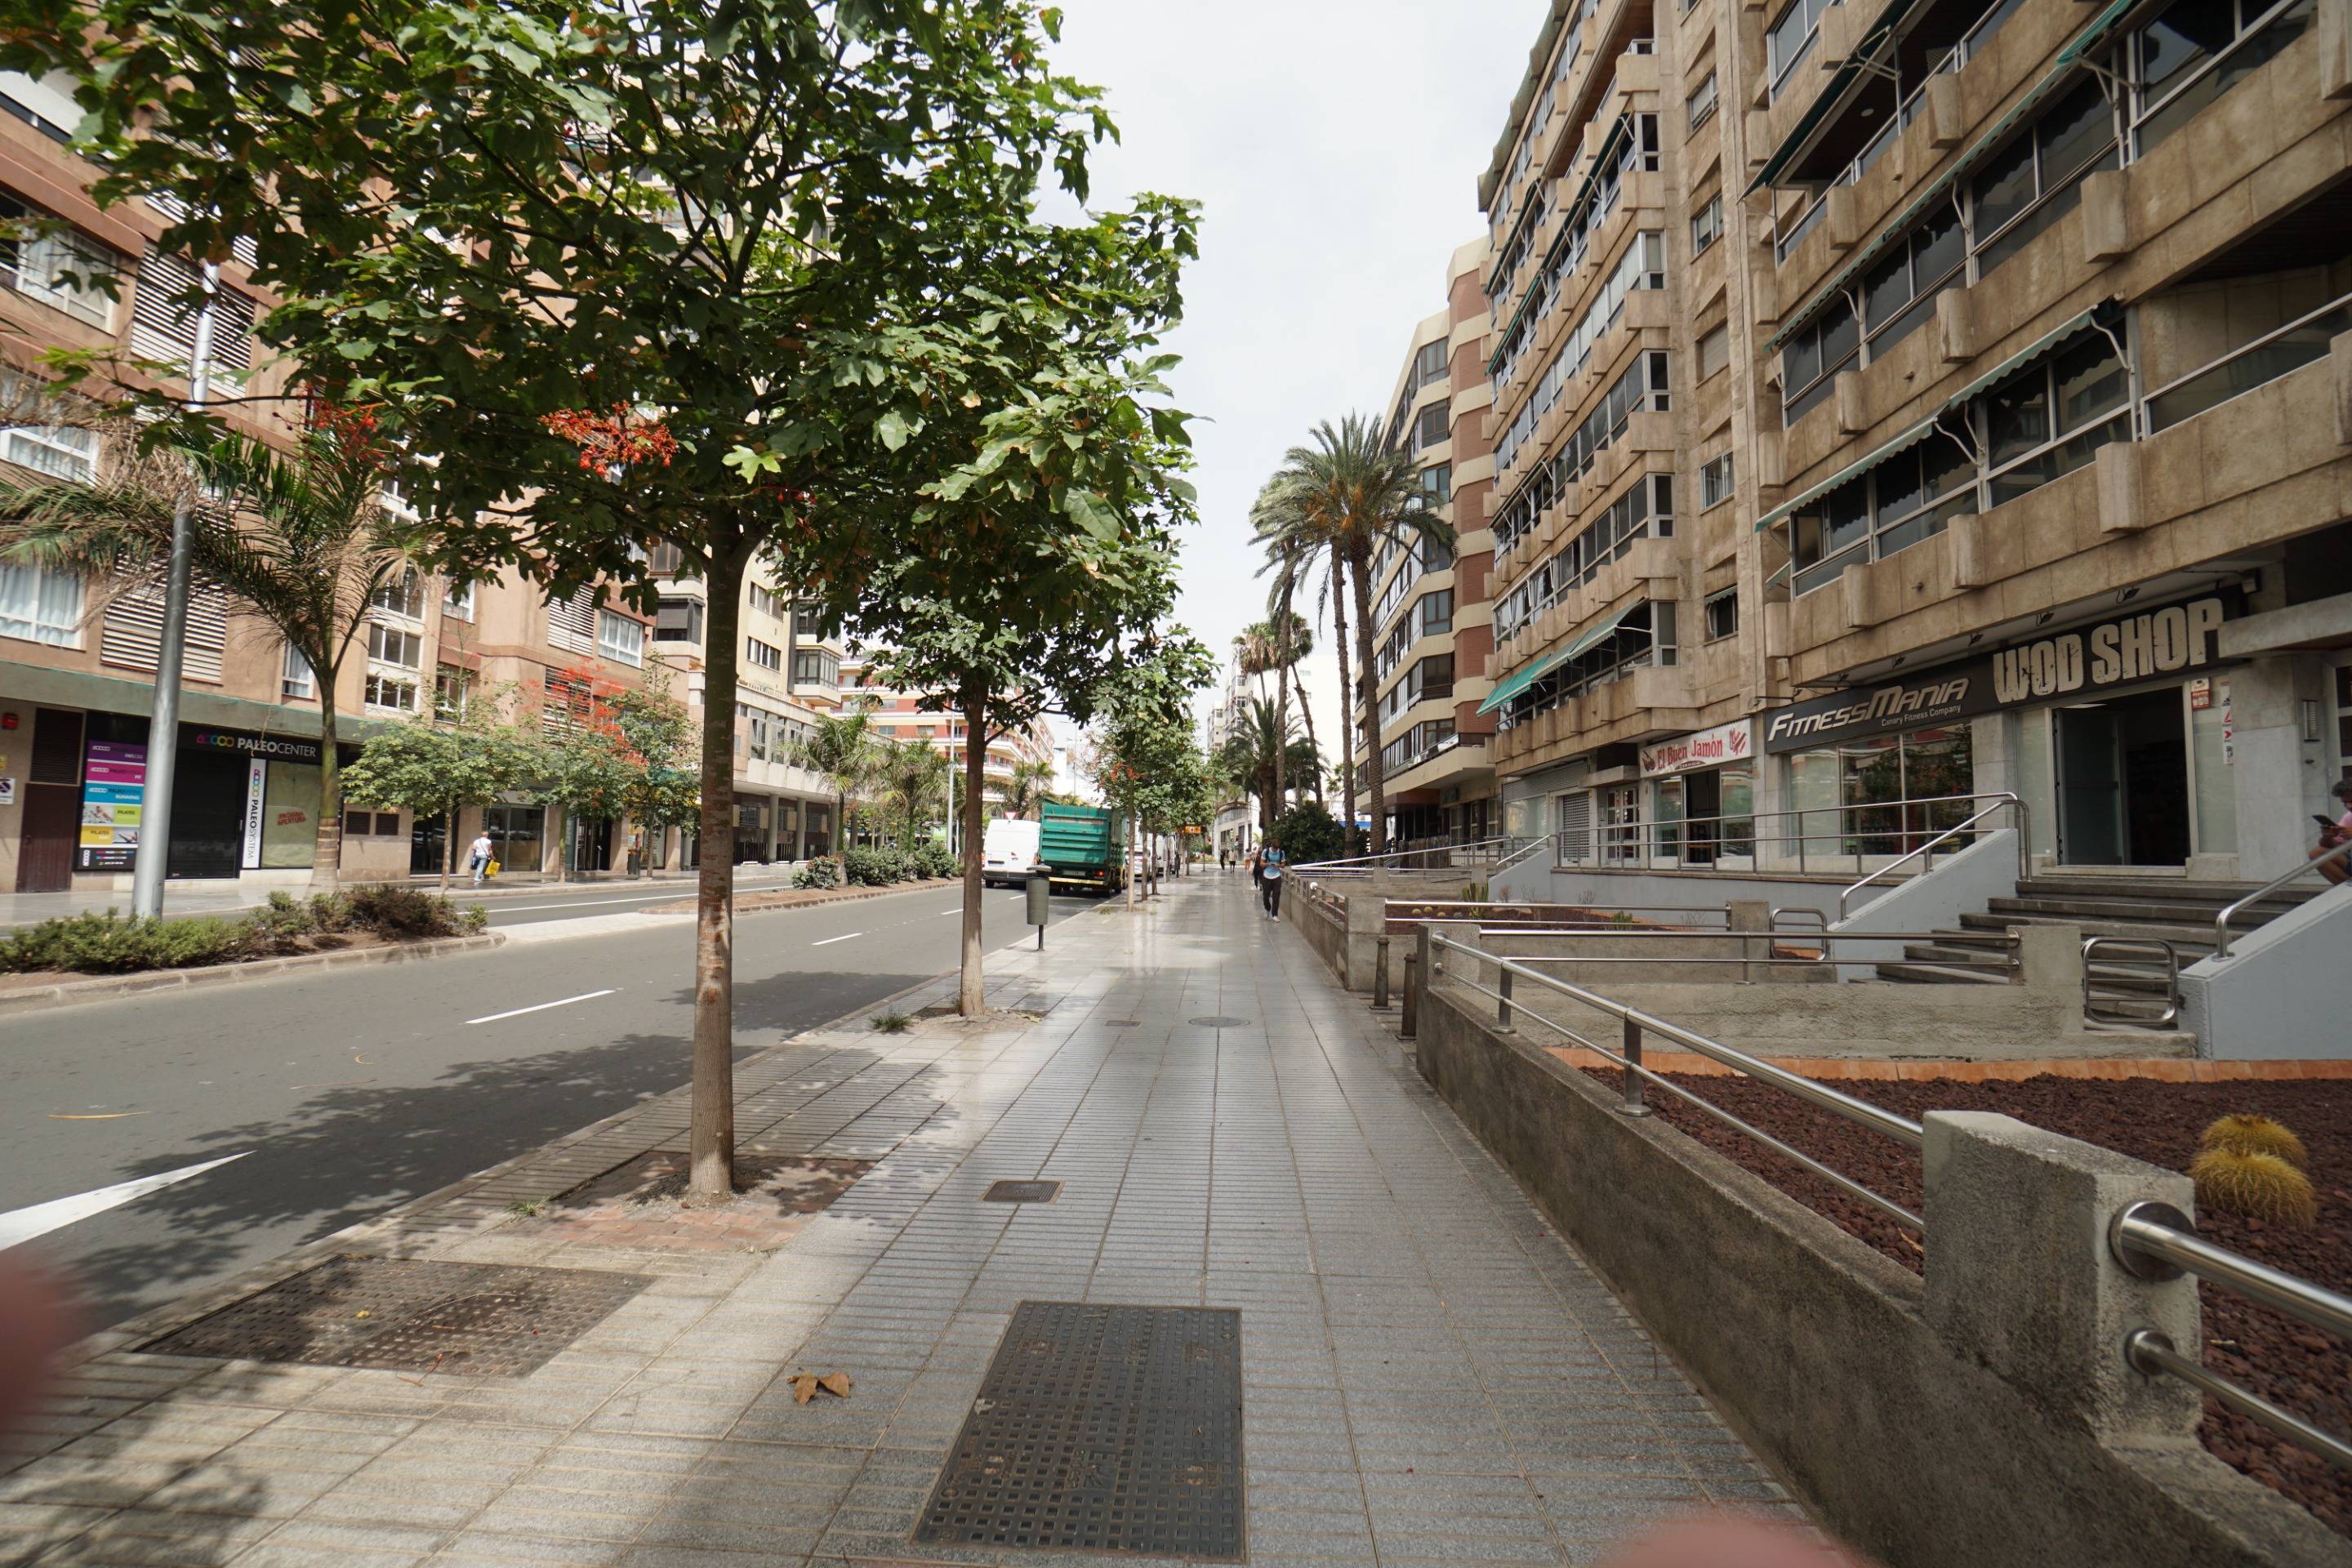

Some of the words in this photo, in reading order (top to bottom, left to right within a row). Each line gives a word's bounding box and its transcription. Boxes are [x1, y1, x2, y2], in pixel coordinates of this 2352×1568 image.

[1993, 634, 2083, 704] WOD
[2091, 598, 2224, 684] SHOP
[1881, 716, 1904, 727] Canary
[1904, 710, 1929, 723] Fitness
[1929, 705, 1962, 717] Company
[237, 737, 317, 757] PALEOCENTER
[1657, 748, 1665, 769] El
[1668, 746, 1688, 765] Buen
[1691, 733, 1723, 758] Jamón
[247, 799, 259, 858] PALEOSYSTEM
